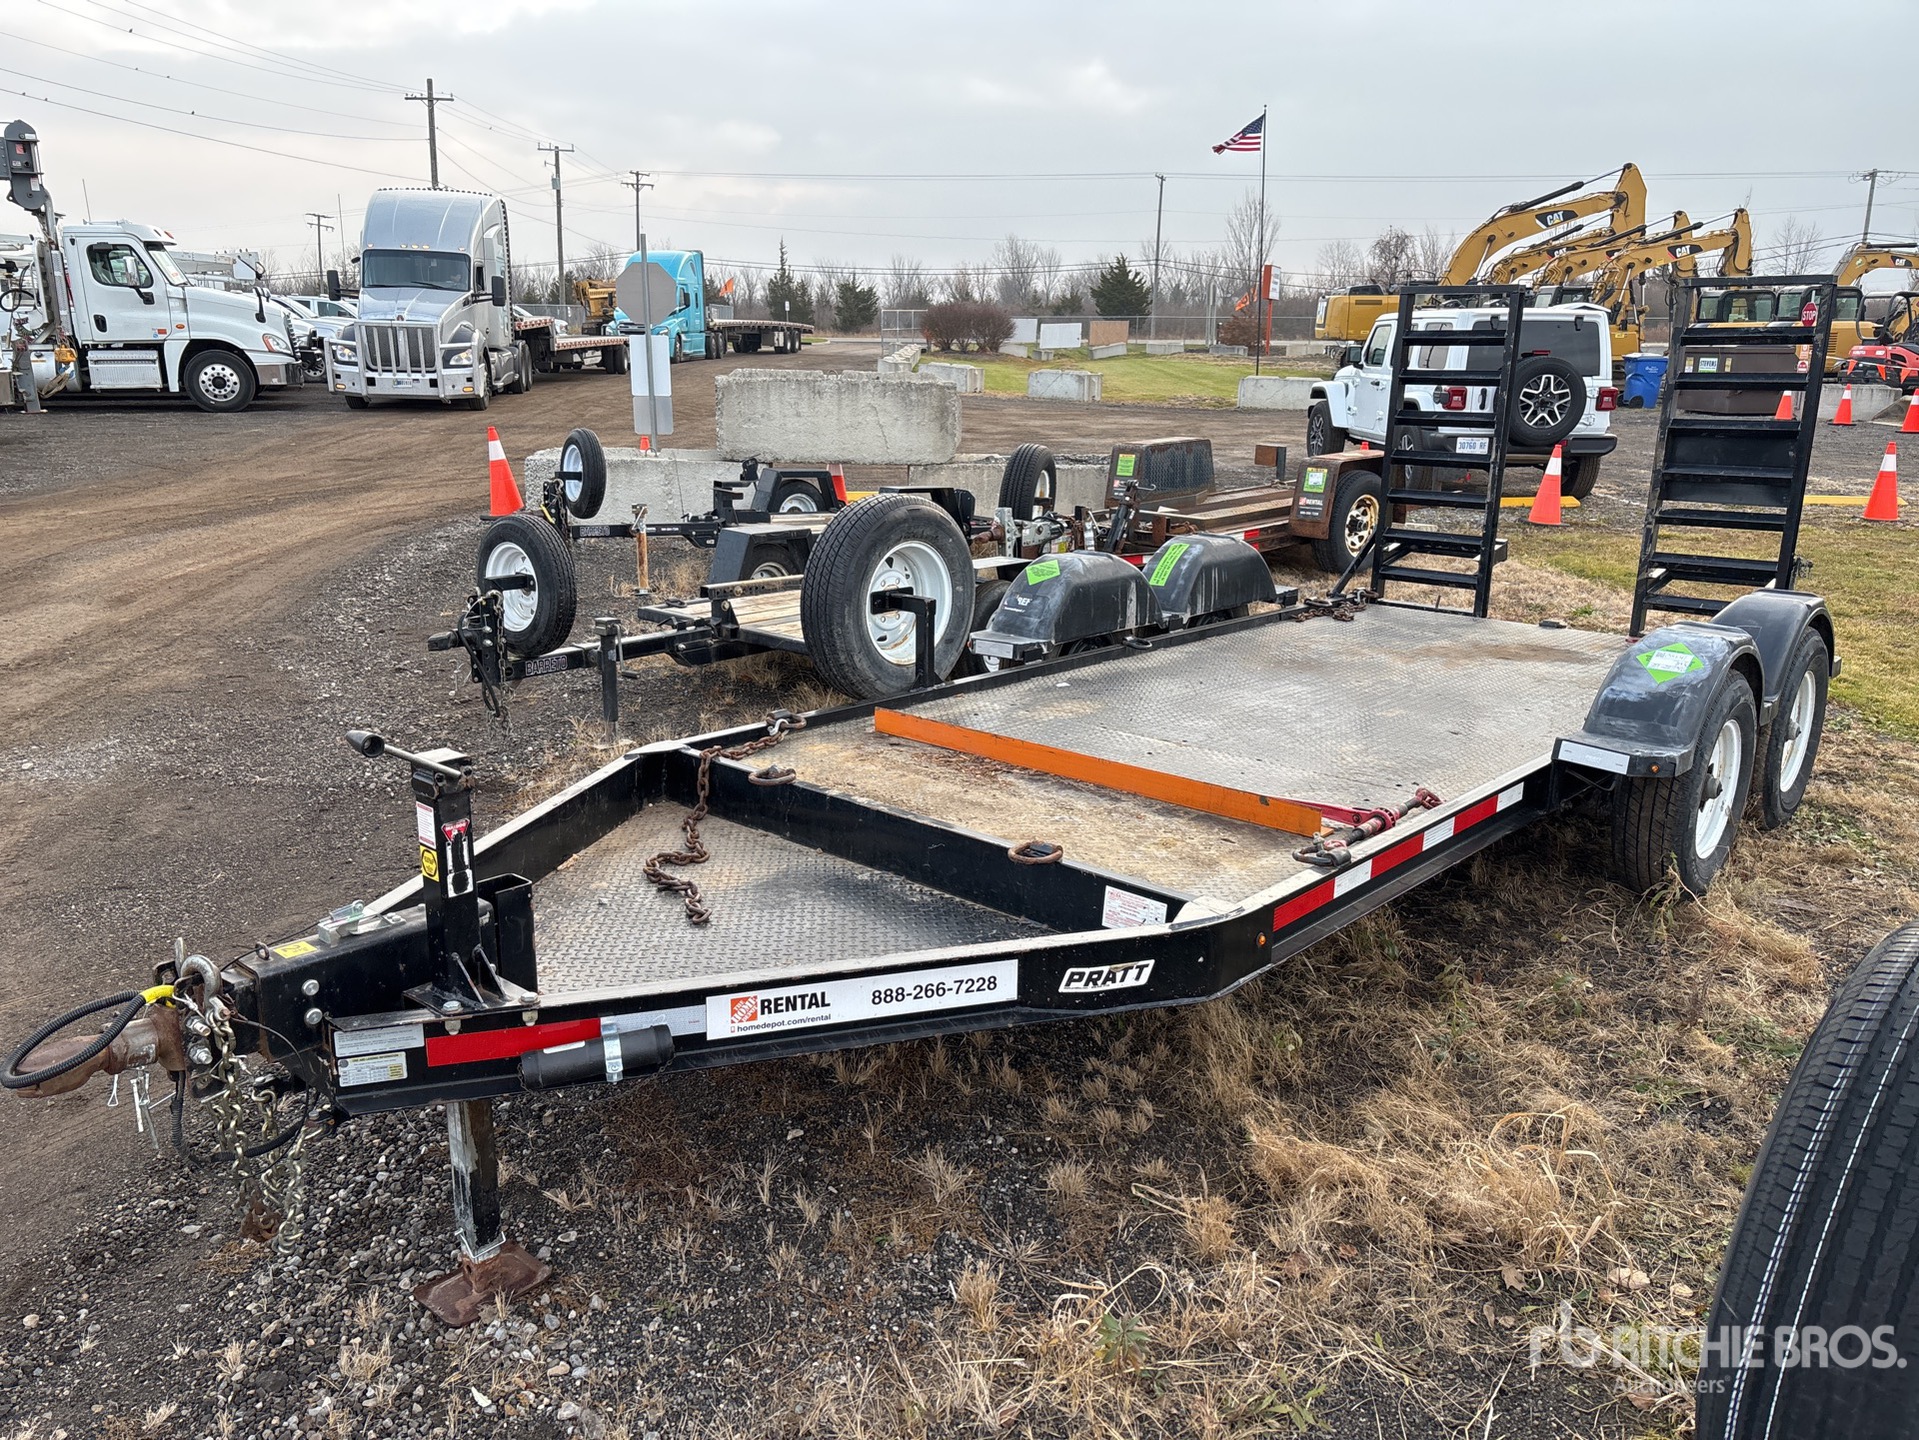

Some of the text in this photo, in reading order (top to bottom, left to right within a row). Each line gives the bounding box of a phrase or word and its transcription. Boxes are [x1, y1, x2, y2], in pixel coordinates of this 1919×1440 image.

[1546, 211, 1564, 225] CAT
[1554, 247, 1567, 257] CAT
[1675, 245, 1690, 258] CAT
[1895, 258, 1906, 266] CAT
[1802, 310, 1816, 321] STOP
[525, 654, 567, 676] BARRETO
[1064, 963, 1150, 987] PRATT
[871, 975, 998, 1006] 888-266-7228
[730, 995, 758, 1023] HOME
[760, 991, 831, 1016] RENTAL
[737, 1013, 832, 1033] homedepot.com/rental
